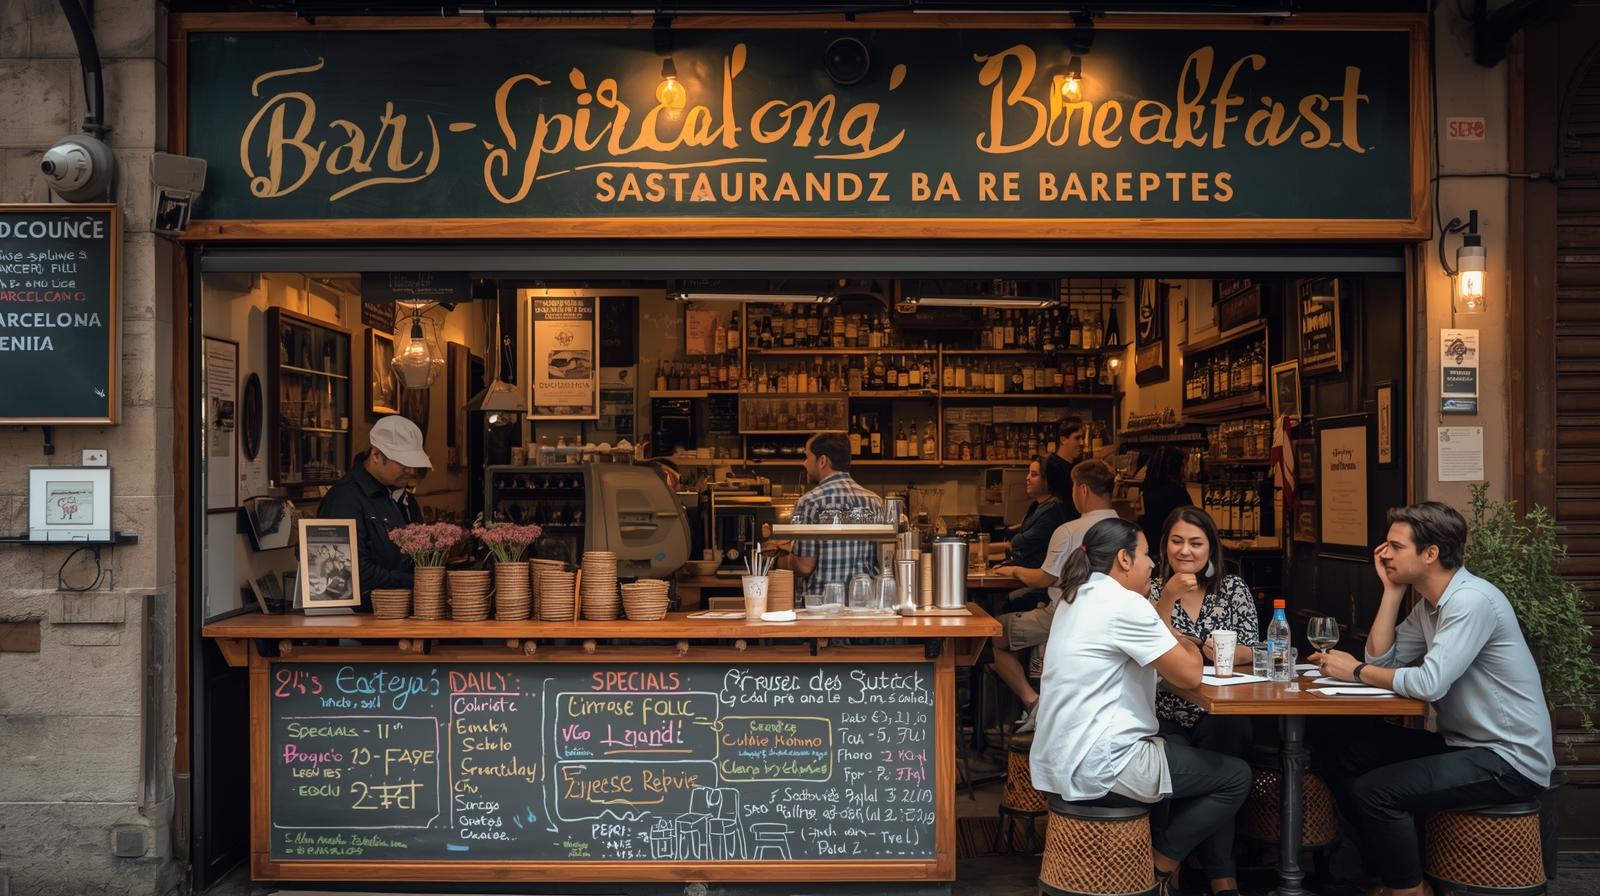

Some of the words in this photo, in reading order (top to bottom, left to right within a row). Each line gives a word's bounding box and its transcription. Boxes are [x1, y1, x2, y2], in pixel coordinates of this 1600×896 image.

[596, 172, 890, 202] SASTAURANDZ
[912, 172, 960, 202] BA
[979, 172, 1020, 202] RE
[1039, 172, 1234, 202] BAREPTES
